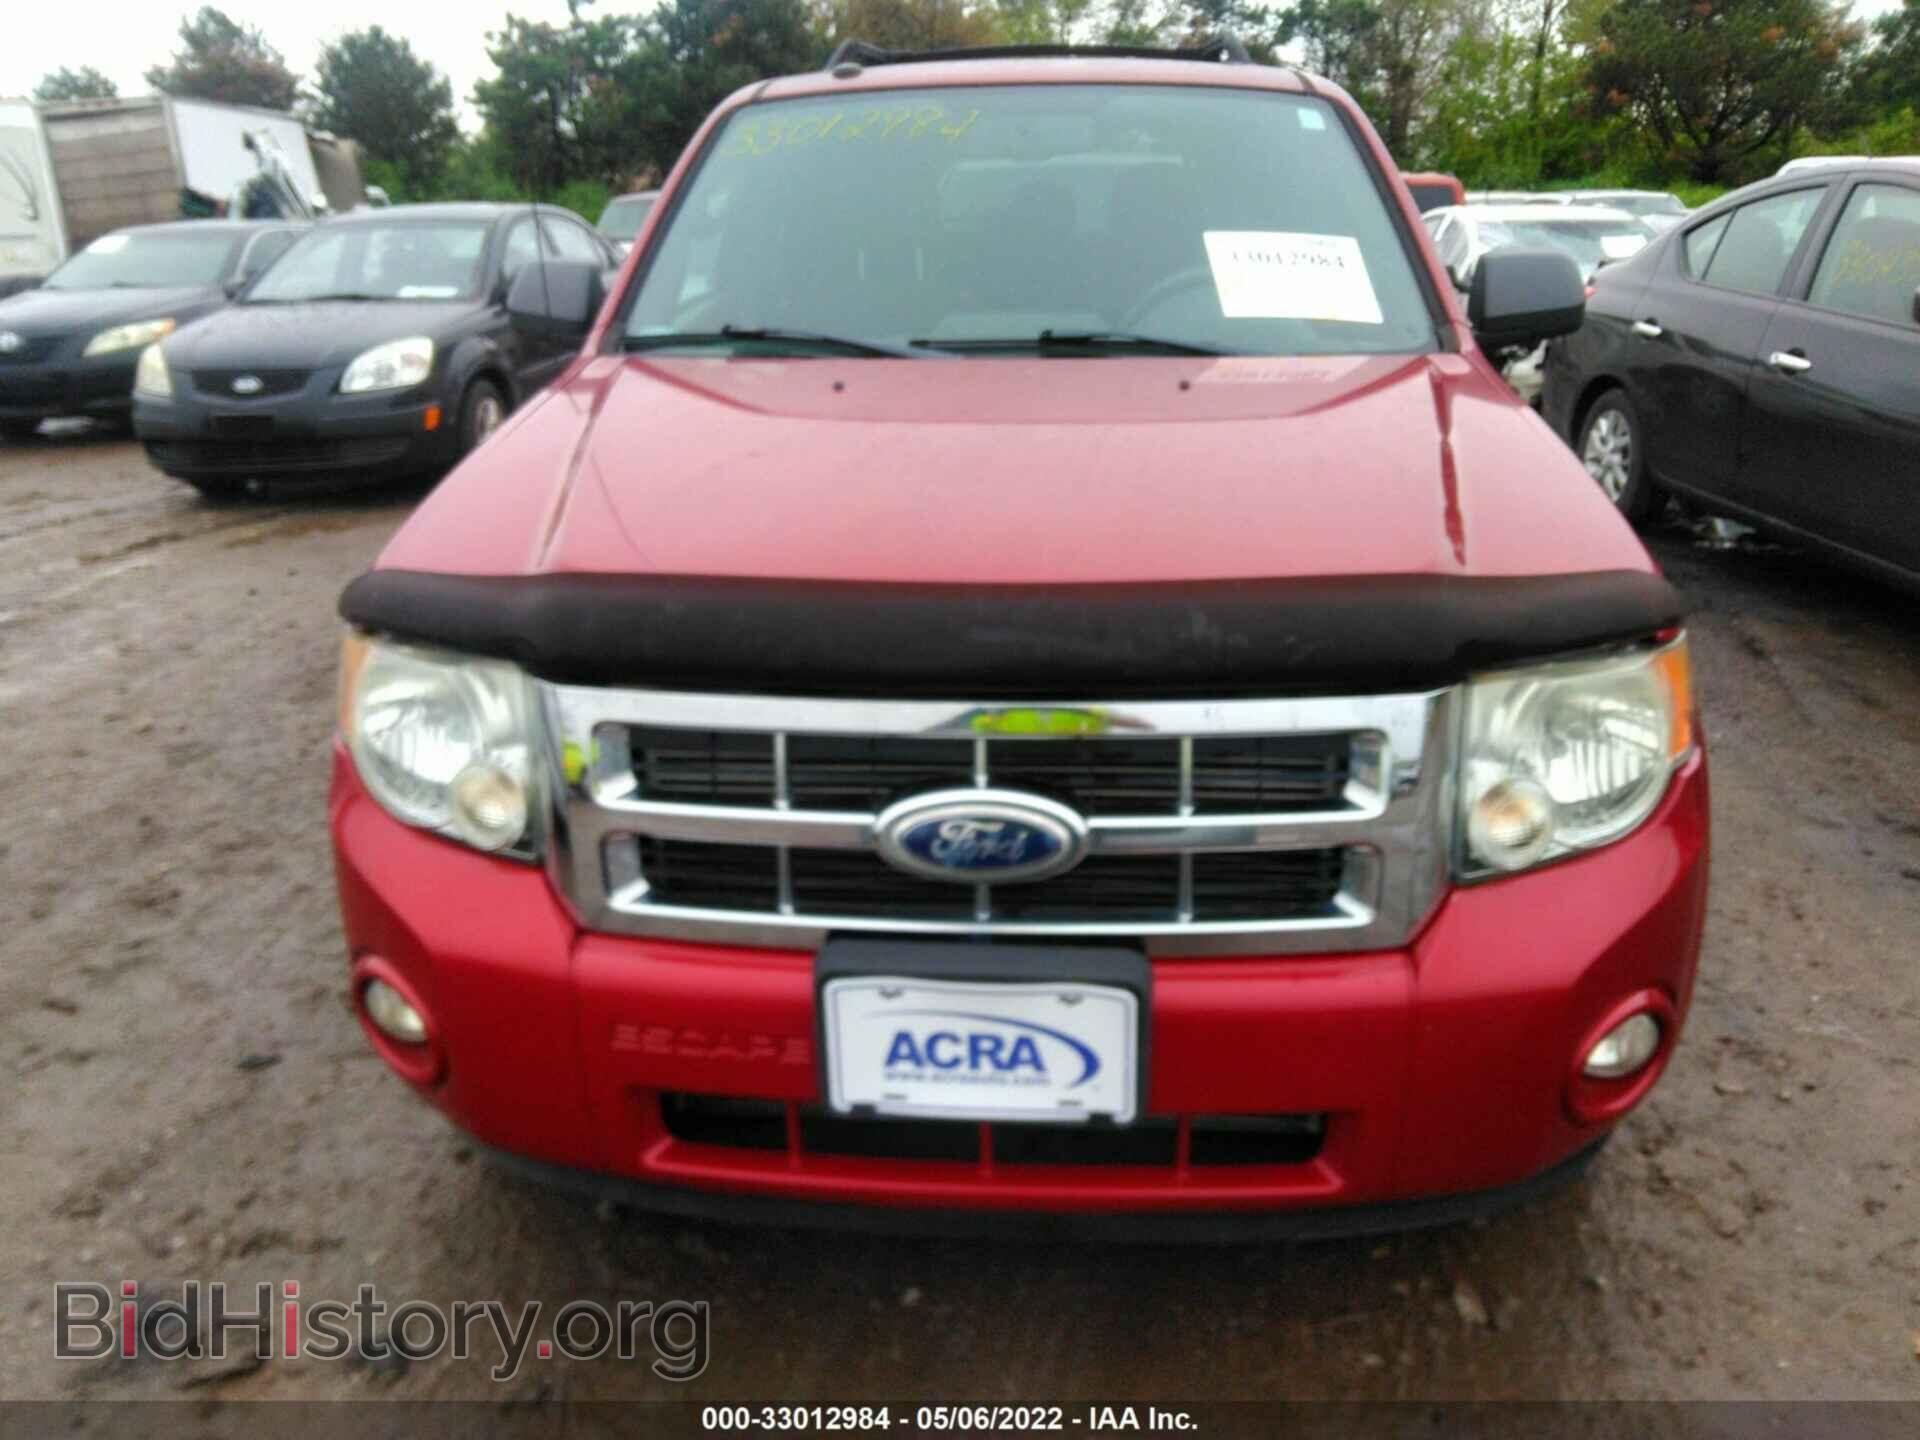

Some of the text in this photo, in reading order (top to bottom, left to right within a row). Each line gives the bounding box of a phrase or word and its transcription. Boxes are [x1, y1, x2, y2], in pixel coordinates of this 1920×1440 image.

[930, 818, 1029, 862] Ford
[610, 1023, 811, 1065] ESCAPE
[884, 1030, 1046, 1071] ACRA
